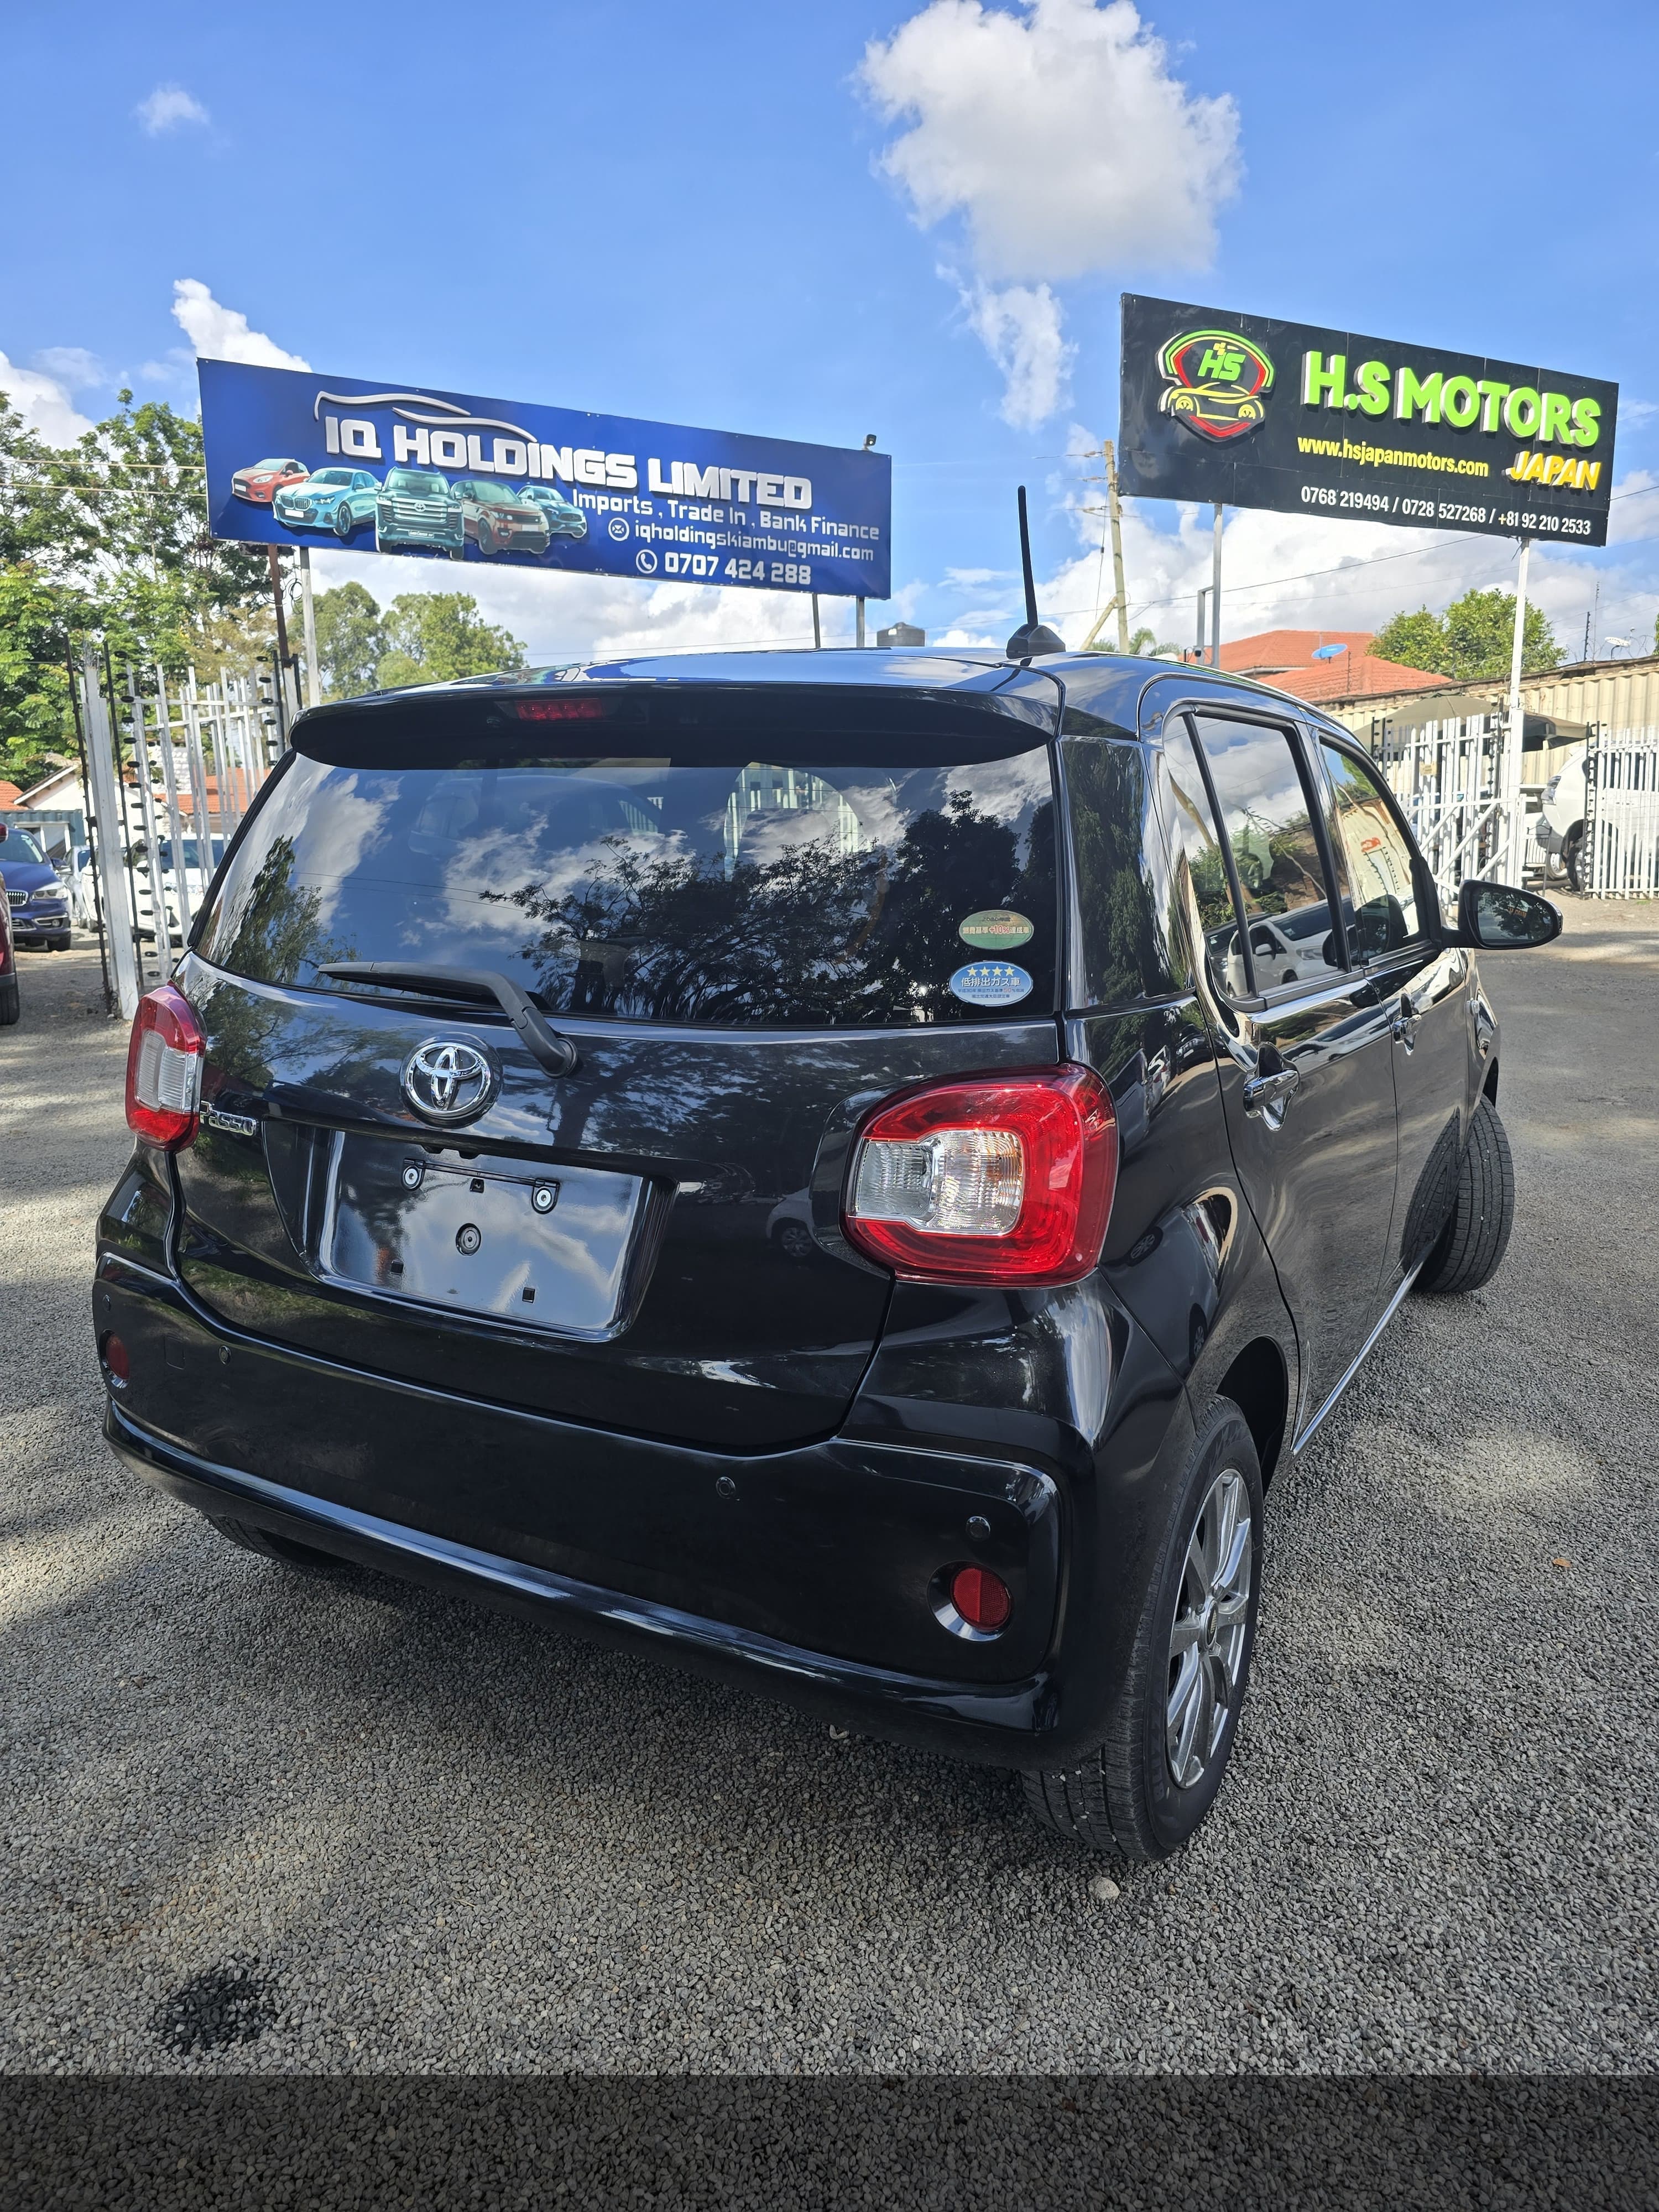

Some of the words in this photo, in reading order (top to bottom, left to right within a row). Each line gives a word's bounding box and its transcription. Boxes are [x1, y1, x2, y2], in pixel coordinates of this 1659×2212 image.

[1197, 349, 1246, 381] HS
[1303, 350, 1391, 415] H.S
[1394, 367, 1601, 447] MOTORS
[325, 415, 382, 459] IQ
[393, 424, 637, 489] HOLDINGS
[648, 458, 812, 509] LIMITED
[1297, 437, 1489, 477] www.hsjapanmotors.com
[1504, 451, 1601, 491] JAPAN
[667, 499, 724, 523] Trade
[729, 507, 745, 525] In
[760, 510, 806, 533] Bank
[811, 515, 880, 540] Finance
[1301, 486, 1337, 505] 0768
[1339, 491, 1389, 512] 219494
[1392, 497, 1399, 513] /
[1402, 498, 1434, 517] 0728
[1438, 503, 1486, 523] 527268
[1489, 508, 1496, 524] /
[1498, 510, 1519, 527] +81
[1521, 513, 1536, 529] 92
[1538, 514, 1559, 531] 210
[1561, 518, 1591, 535] 2533
[635, 519, 874, 561] iqholdingskiambu@gmail.com
[665, 551, 719, 576] 0707
[724, 557, 765, 581] 424
[771, 562, 811, 585] 288
[961, 977, 1021, 987] 低排出ガス車
